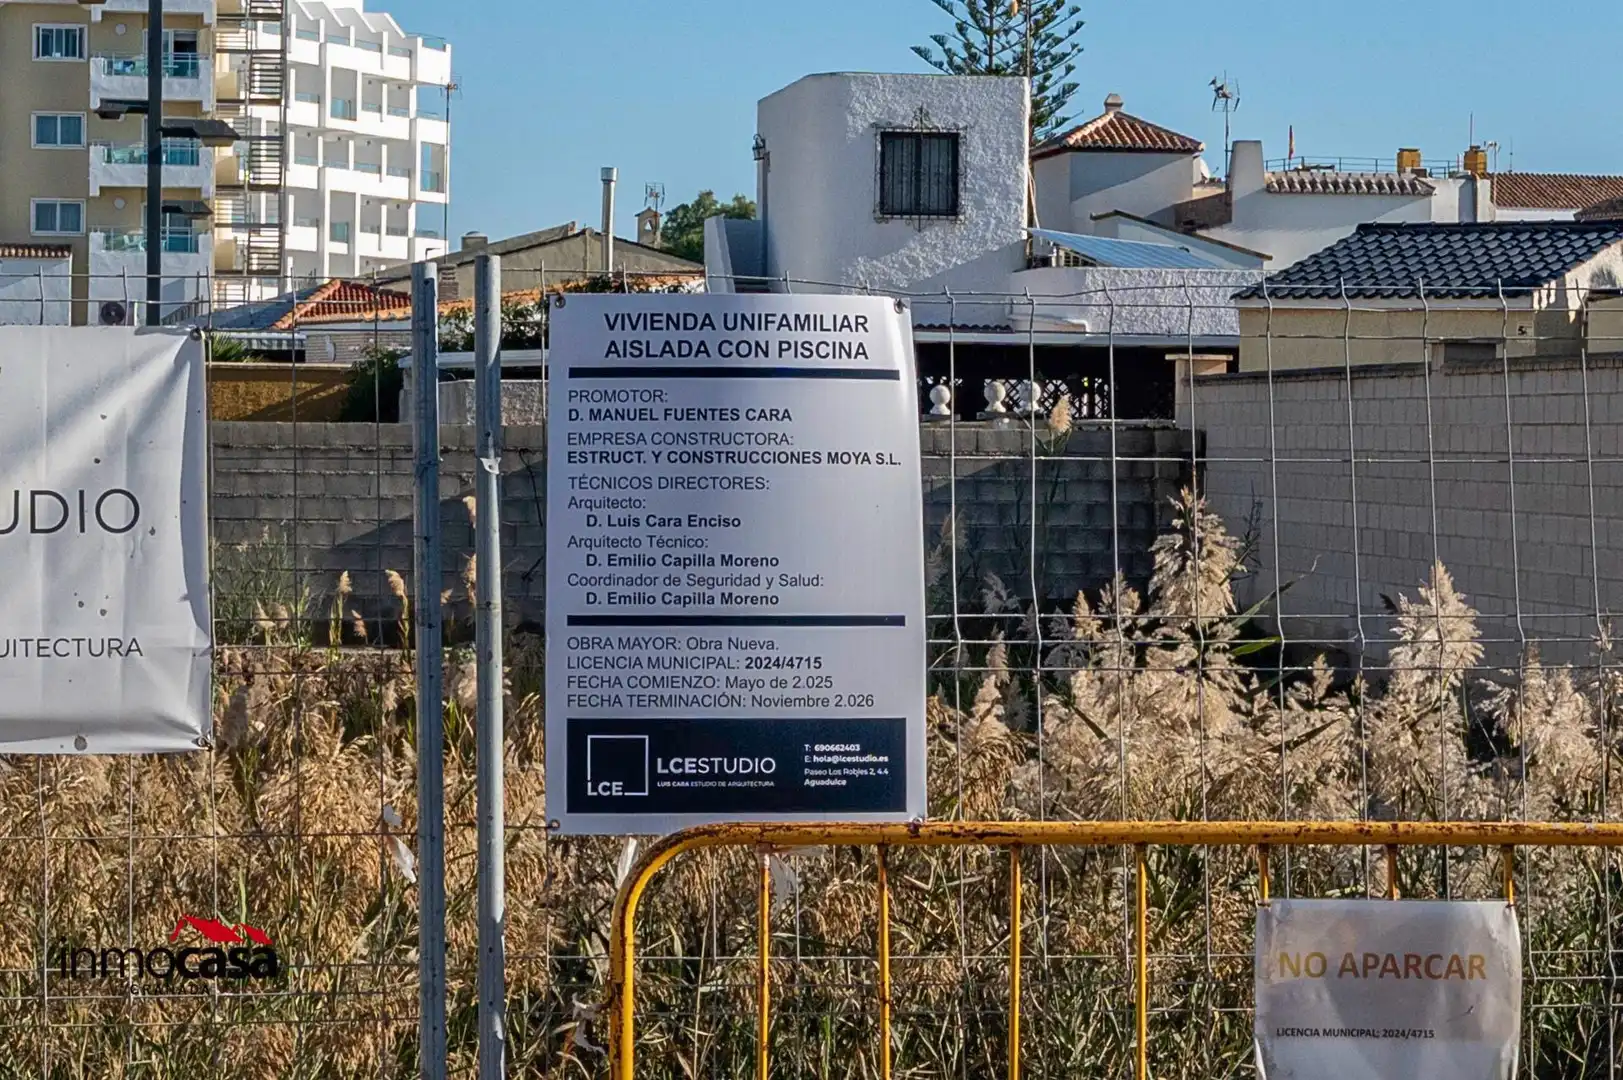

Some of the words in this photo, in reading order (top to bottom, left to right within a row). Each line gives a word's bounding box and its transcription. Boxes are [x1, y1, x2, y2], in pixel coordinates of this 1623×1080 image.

[604, 313, 716, 331] VIVIENDA
[723, 313, 869, 333] UNIFAMILIAR
[604, 340, 711, 358] AISLADA
[718, 340, 769, 358] CON
[778, 340, 869, 360] PISCINA
[568, 389, 668, 403] PROMOTOR:
[568, 408, 584, 422] D.
[589, 408, 659, 422] MANUEL
[664, 408, 740, 422] FUENTES
[745, 408, 792, 422] CARA
[568, 432, 647, 445] EMPRESA
[651, 432, 794, 446] CONSTRUCTORA:
[568, 451, 646, 464] ESTRUCT.
[652, 451, 662, 464] Y
[667, 450, 822, 465] CONSTRUCCIONES
[827, 452, 871, 465] MOYA
[876, 452, 902, 466] S.L.
[568, 473, 652, 490] TÉCNICOS
[658, 476, 770, 490] DIRECTORES:
[568, 496, 646, 512] Arquitecto:
[586, 514, 602, 528] D.
[608, 514, 640, 528] Luis
[646, 514, 682, 528] Cara
[688, 514, 741, 528] Enciso
[567, 535, 642, 551] Arquitecto
[646, 535, 709, 549] Técnico:
[586, 554, 602, 567] D.
[608, 554, 656, 567] Emilio
[662, 554, 715, 571] Capilla
[721, 554, 779, 567] Moreno
[568, 573, 659, 587] Coordinador
[663, 574, 681, 587] de
[686, 573, 760, 590] Seguridad
[765, 577, 774, 590] y
[779, 574, 824, 587] Salud:
[586, 592, 602, 605] D.
[608, 592, 656, 605] Emilio
[662, 592, 715, 609] Capilla
[721, 592, 779, 606] Moreno
[567, 637, 614, 651] OBRA
[618, 637, 682, 651] MAYOR:
[686, 636, 722, 651] Obra
[728, 637, 779, 651] Nueva.
[568, 656, 643, 670] LICENCIA
[648, 656, 740, 670] MUNICIPAL:
[745, 656, 822, 670] 2024/4715
[568, 675, 623, 688] FECHA
[626, 675, 721, 689] COMIENZO:
[725, 676, 765, 692] Mayo
[770, 676, 788, 689] de
[792, 676, 833, 689] 2.025
[567, 694, 623, 707] FECHA
[626, 690, 746, 708] TERMINACIÓN:
[751, 694, 830, 708] Noviembre
[834, 694, 874, 707] 2.026
[656, 757, 776, 774] LCESTUDIO
[587, 781, 623, 796] LCE
[657, 780, 671, 788] LUIS
[690, 780, 717, 788] ESTUDIO
[718, 780, 726, 788] DE
[804, 779, 847, 787] Aguadulce
[1279, 952, 1327, 978] NO
[1337, 952, 1487, 980] APARCAR
[1276, 1027, 1320, 1038] LICENCIA
[1322, 1028, 1380, 1038] MUNICIPAL:
[1382, 1028, 1435, 1039] 2024/4715
